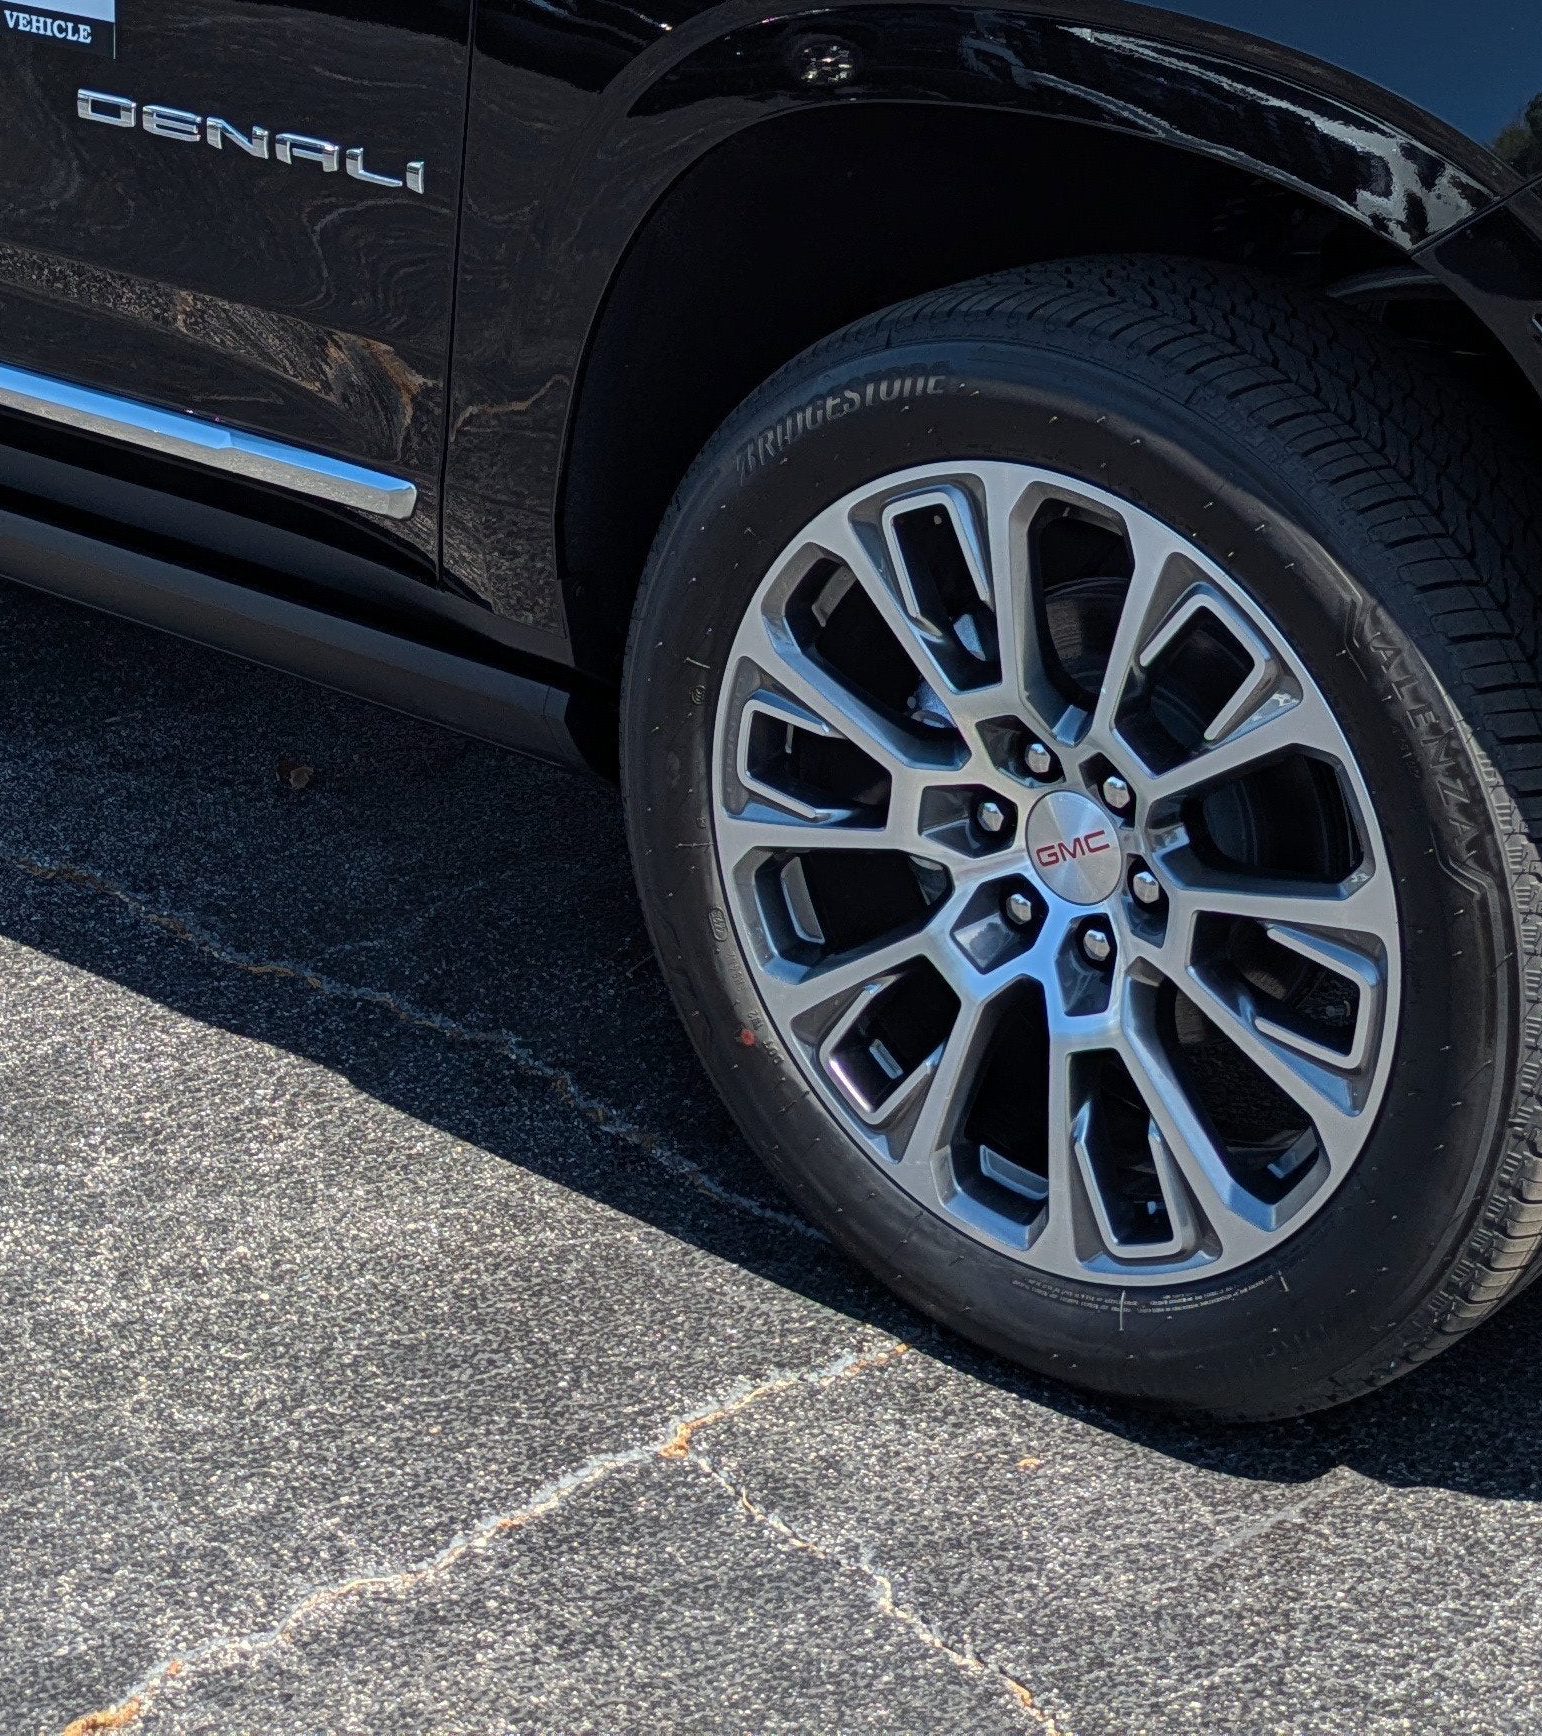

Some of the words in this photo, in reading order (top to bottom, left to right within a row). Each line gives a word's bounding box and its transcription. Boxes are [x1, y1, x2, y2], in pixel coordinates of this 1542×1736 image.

[4, 9, 93, 44] VEHICLE
[76, 88, 425, 195] DENALI
[1035, 829, 1111, 867] GMC
